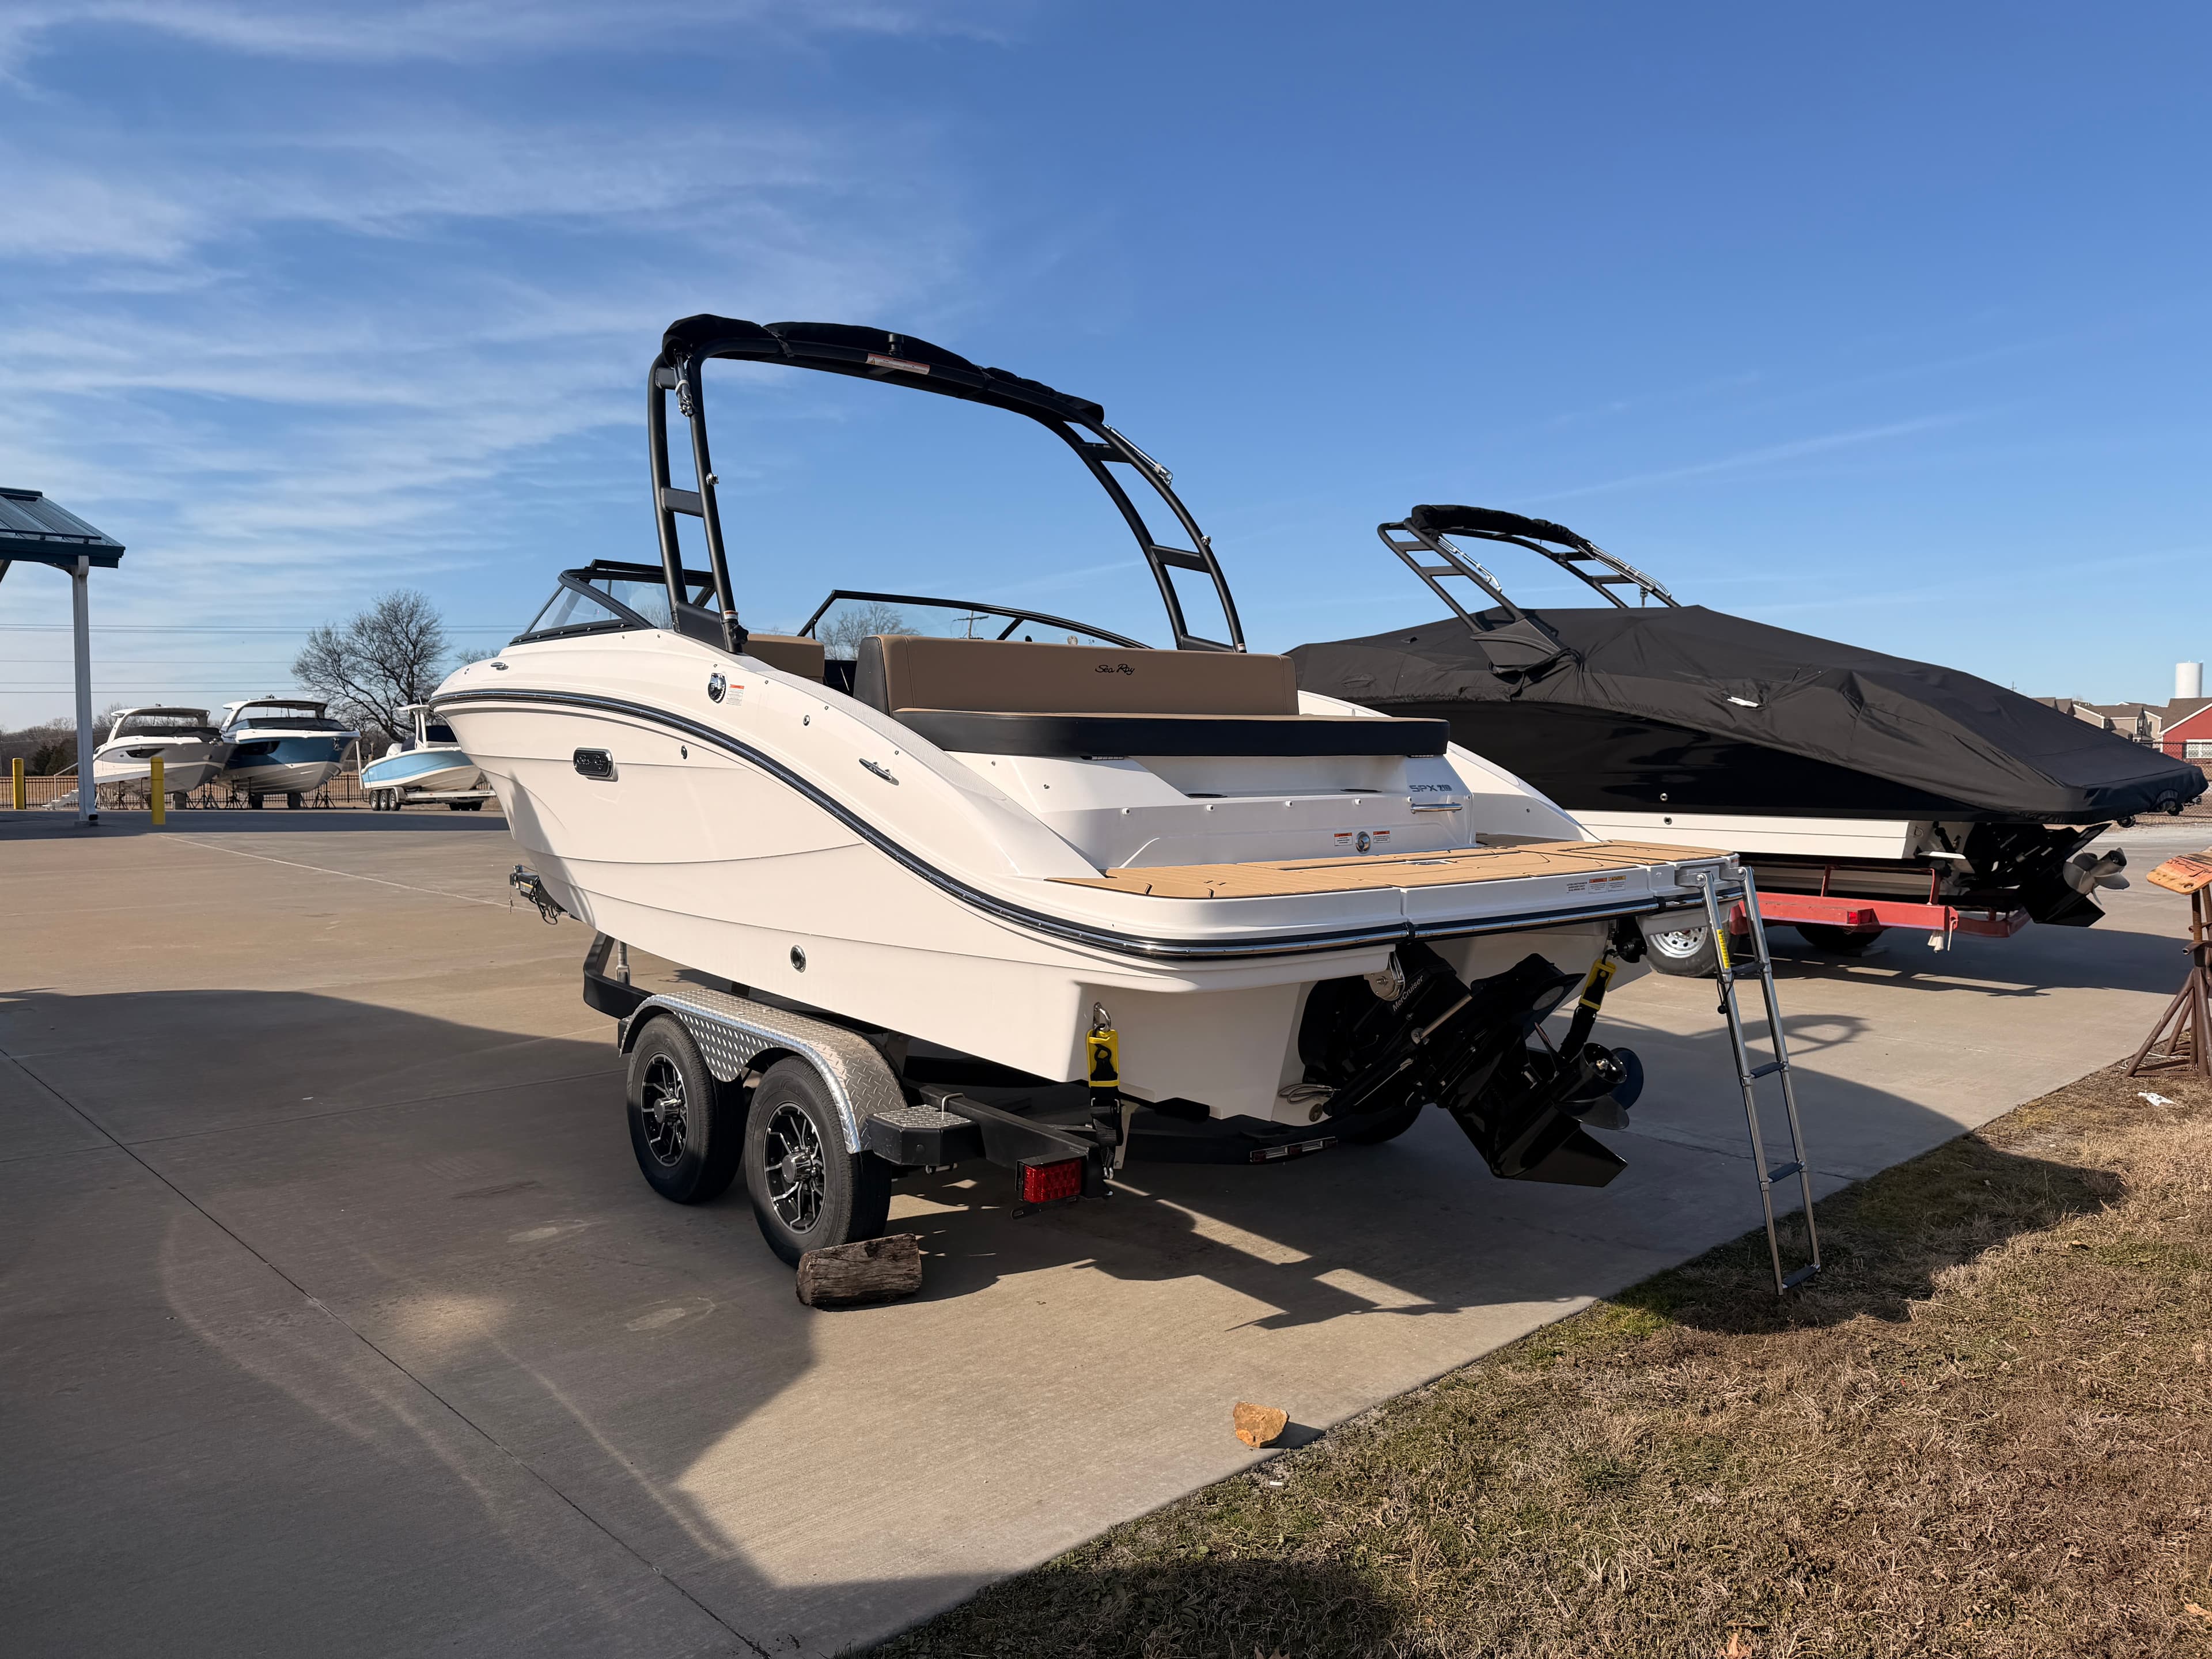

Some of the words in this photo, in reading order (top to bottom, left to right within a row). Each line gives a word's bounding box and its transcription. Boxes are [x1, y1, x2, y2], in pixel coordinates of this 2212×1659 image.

[1095, 664, 1115, 673] Sea
[1116, 664, 1135, 675] Ray
[1392, 975, 1423, 1012] MerCruiser
